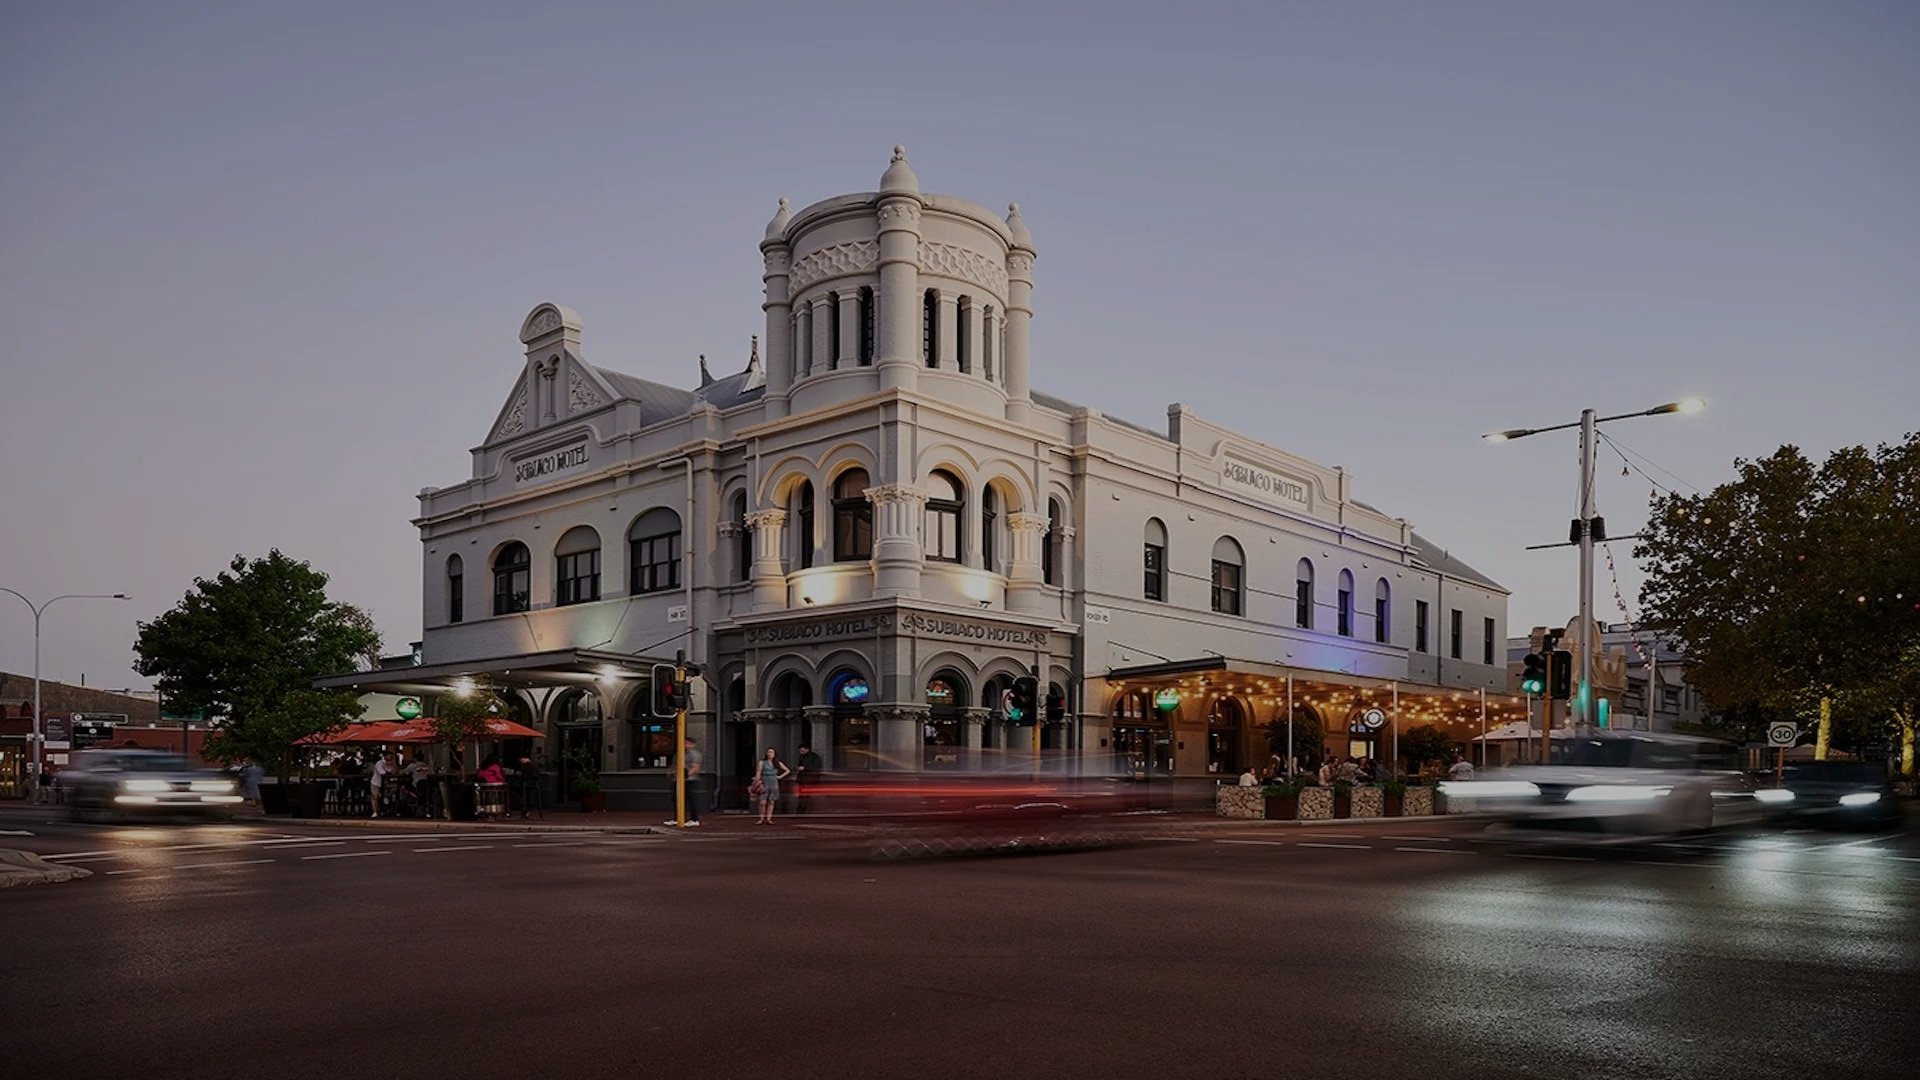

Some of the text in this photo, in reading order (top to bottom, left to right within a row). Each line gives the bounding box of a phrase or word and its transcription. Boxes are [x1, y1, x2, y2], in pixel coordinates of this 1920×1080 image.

[557, 444, 589, 470] HOTEL
[1272, 477, 1307, 503] HOTEL
[767, 619, 869, 641] SUBIACO HOTEL
[926, 619, 1028, 644] SUBIACO HOTEL
[1775, 730, 1790, 739] 30
